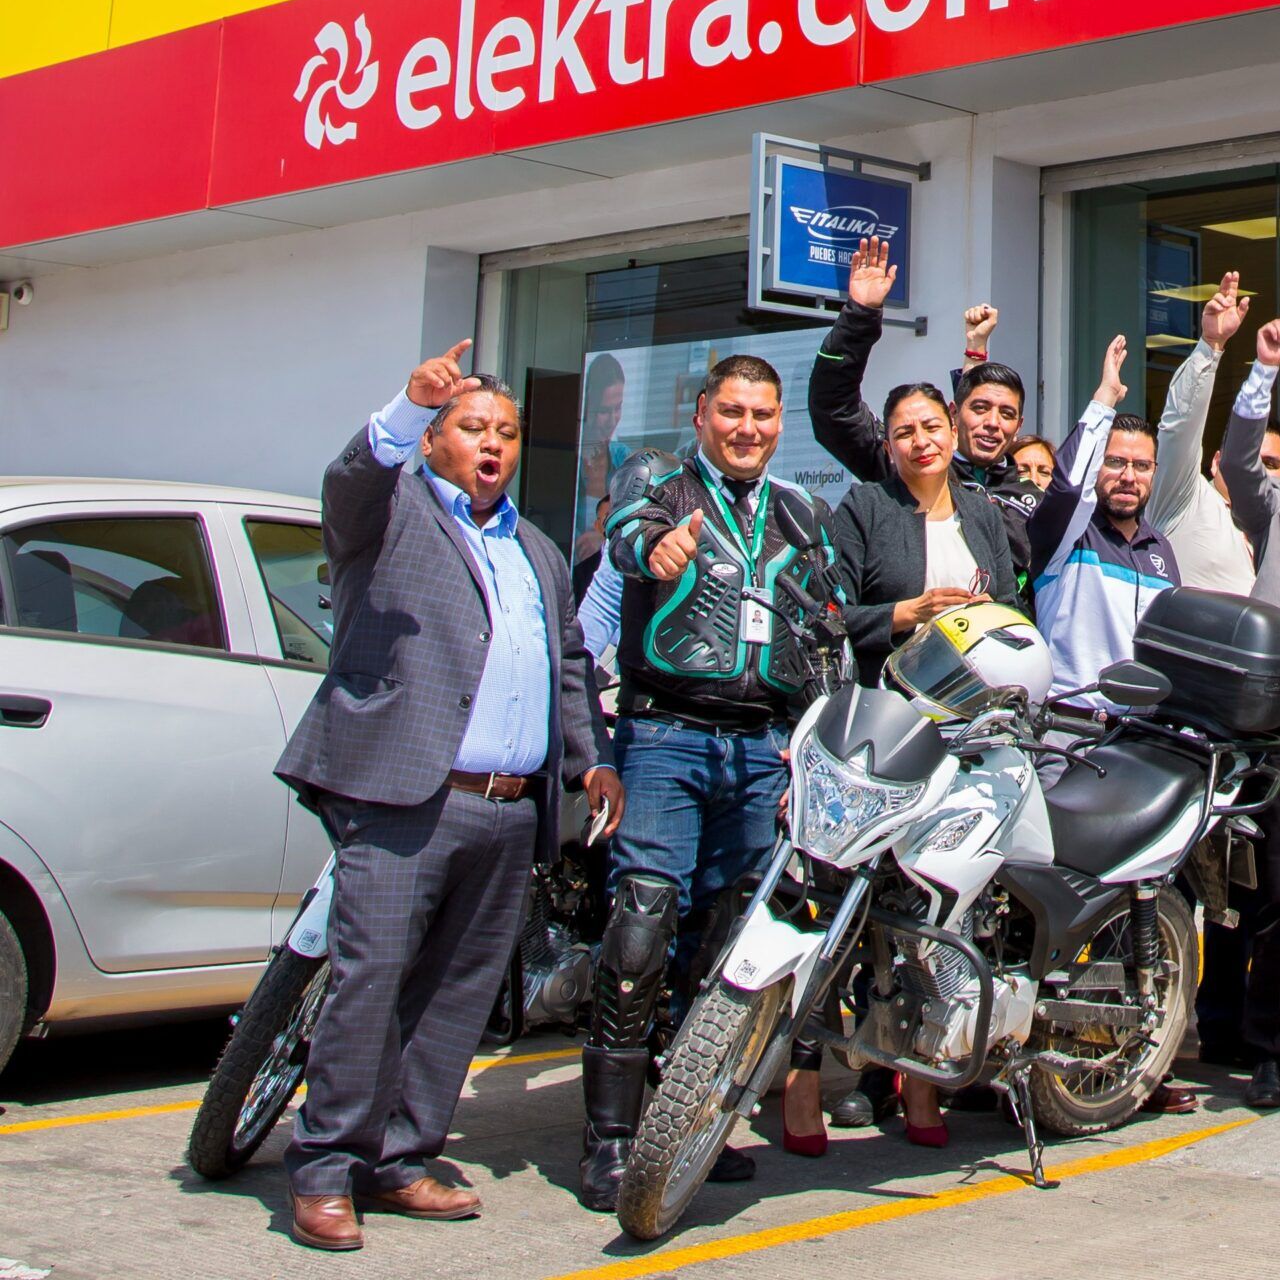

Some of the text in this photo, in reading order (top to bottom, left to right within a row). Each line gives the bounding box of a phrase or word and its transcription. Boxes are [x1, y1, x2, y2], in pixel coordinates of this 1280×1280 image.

[810, 212, 876, 236] ITALIKA
[810, 245, 836, 263] PUEDES
[795, 468, 844, 488] Whirlpool
